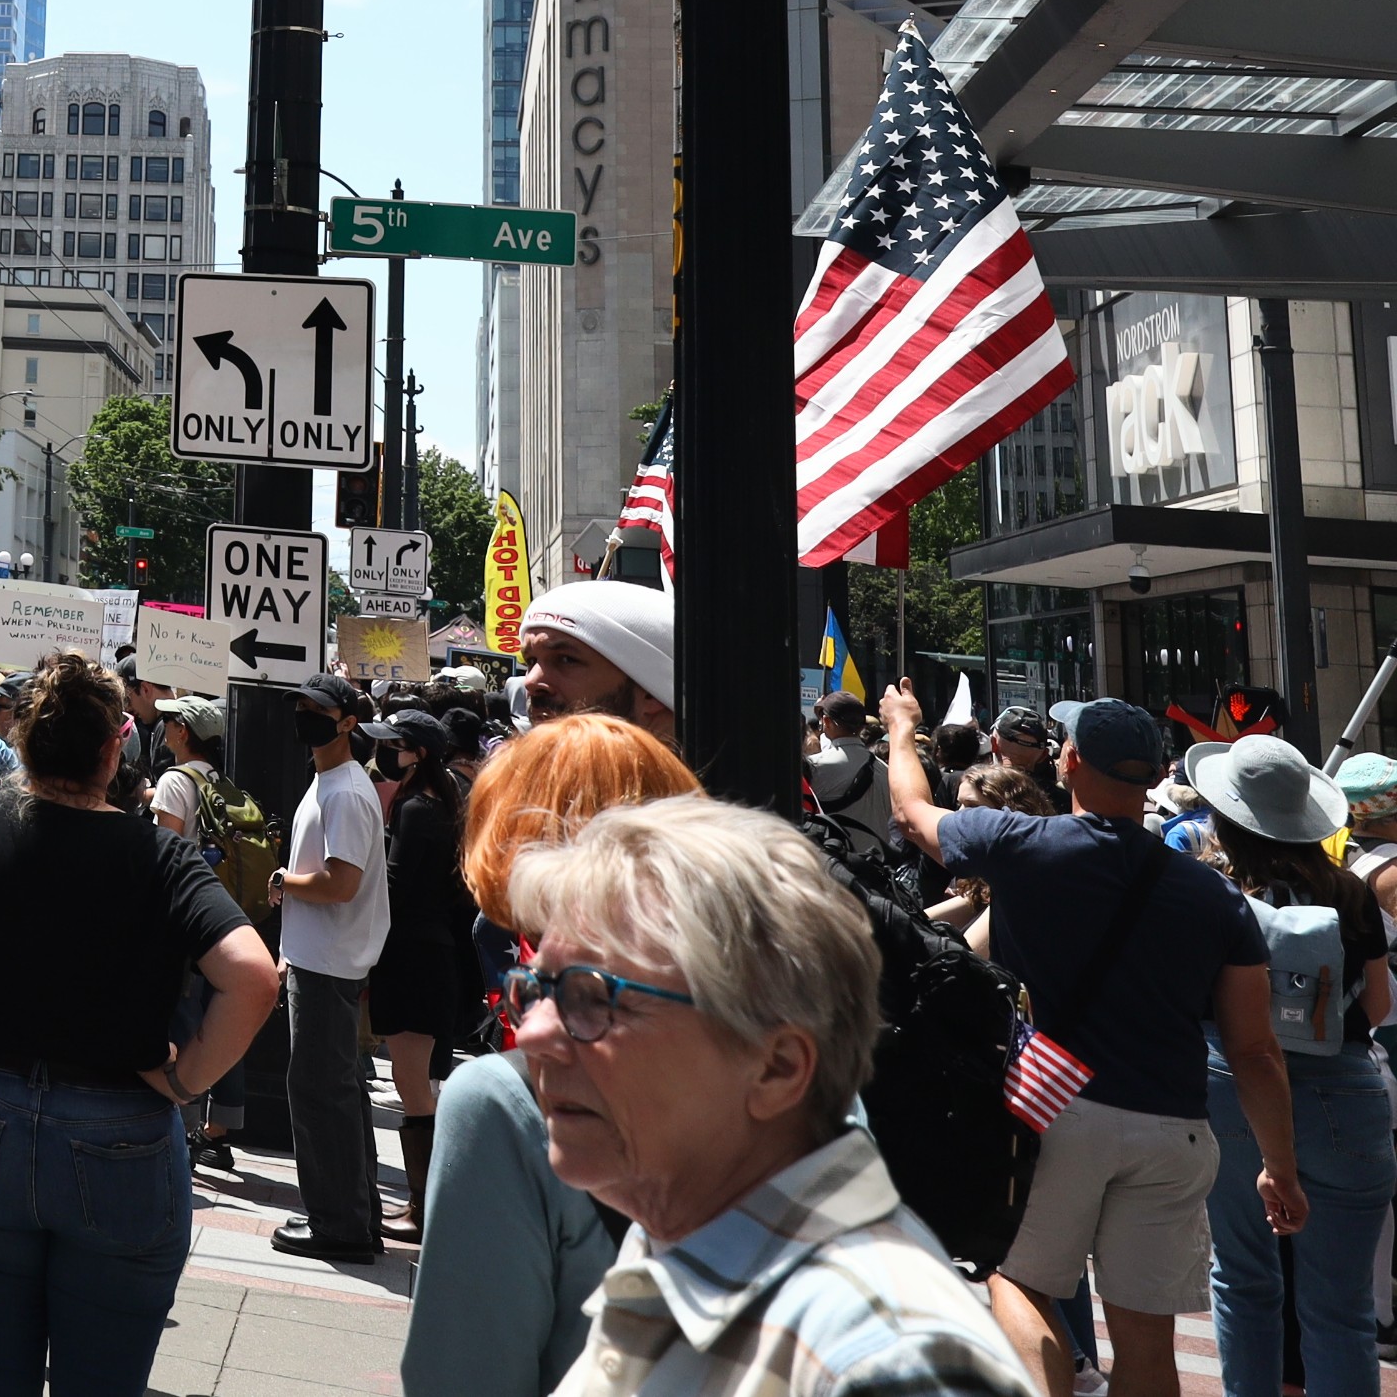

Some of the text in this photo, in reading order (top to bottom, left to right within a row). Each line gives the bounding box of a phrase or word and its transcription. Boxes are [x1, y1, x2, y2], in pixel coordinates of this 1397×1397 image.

[351, 205, 552, 251] 5th Ave
[1116, 302, 1180, 365] NORDSTROM
[1106, 342, 1206, 478] rack
[182, 413, 363, 454] ONLY ONLY
[224, 540, 311, 582] ONE
[354, 567, 421, 581] ONLY ONLY
[11, 600, 85, 621] REMEMBER
[122, 598, 137, 608] my
[220, 583, 312, 626] WAY
[365, 600, 411, 614] AHEAD
[1, 616, 32, 627] WHEN
[47, 619, 101, 635] PRESIDENT
[104, 613, 122, 624] INE
[9, 632, 46, 640] WASN'T
[56, 634, 101, 645] FASCIST?
[150, 623, 216, 649] No to Kings
[148, 644, 223, 669] Yes to Queens
[473, 661, 492, 673] NO
[356, 663, 404, 679] ICE
